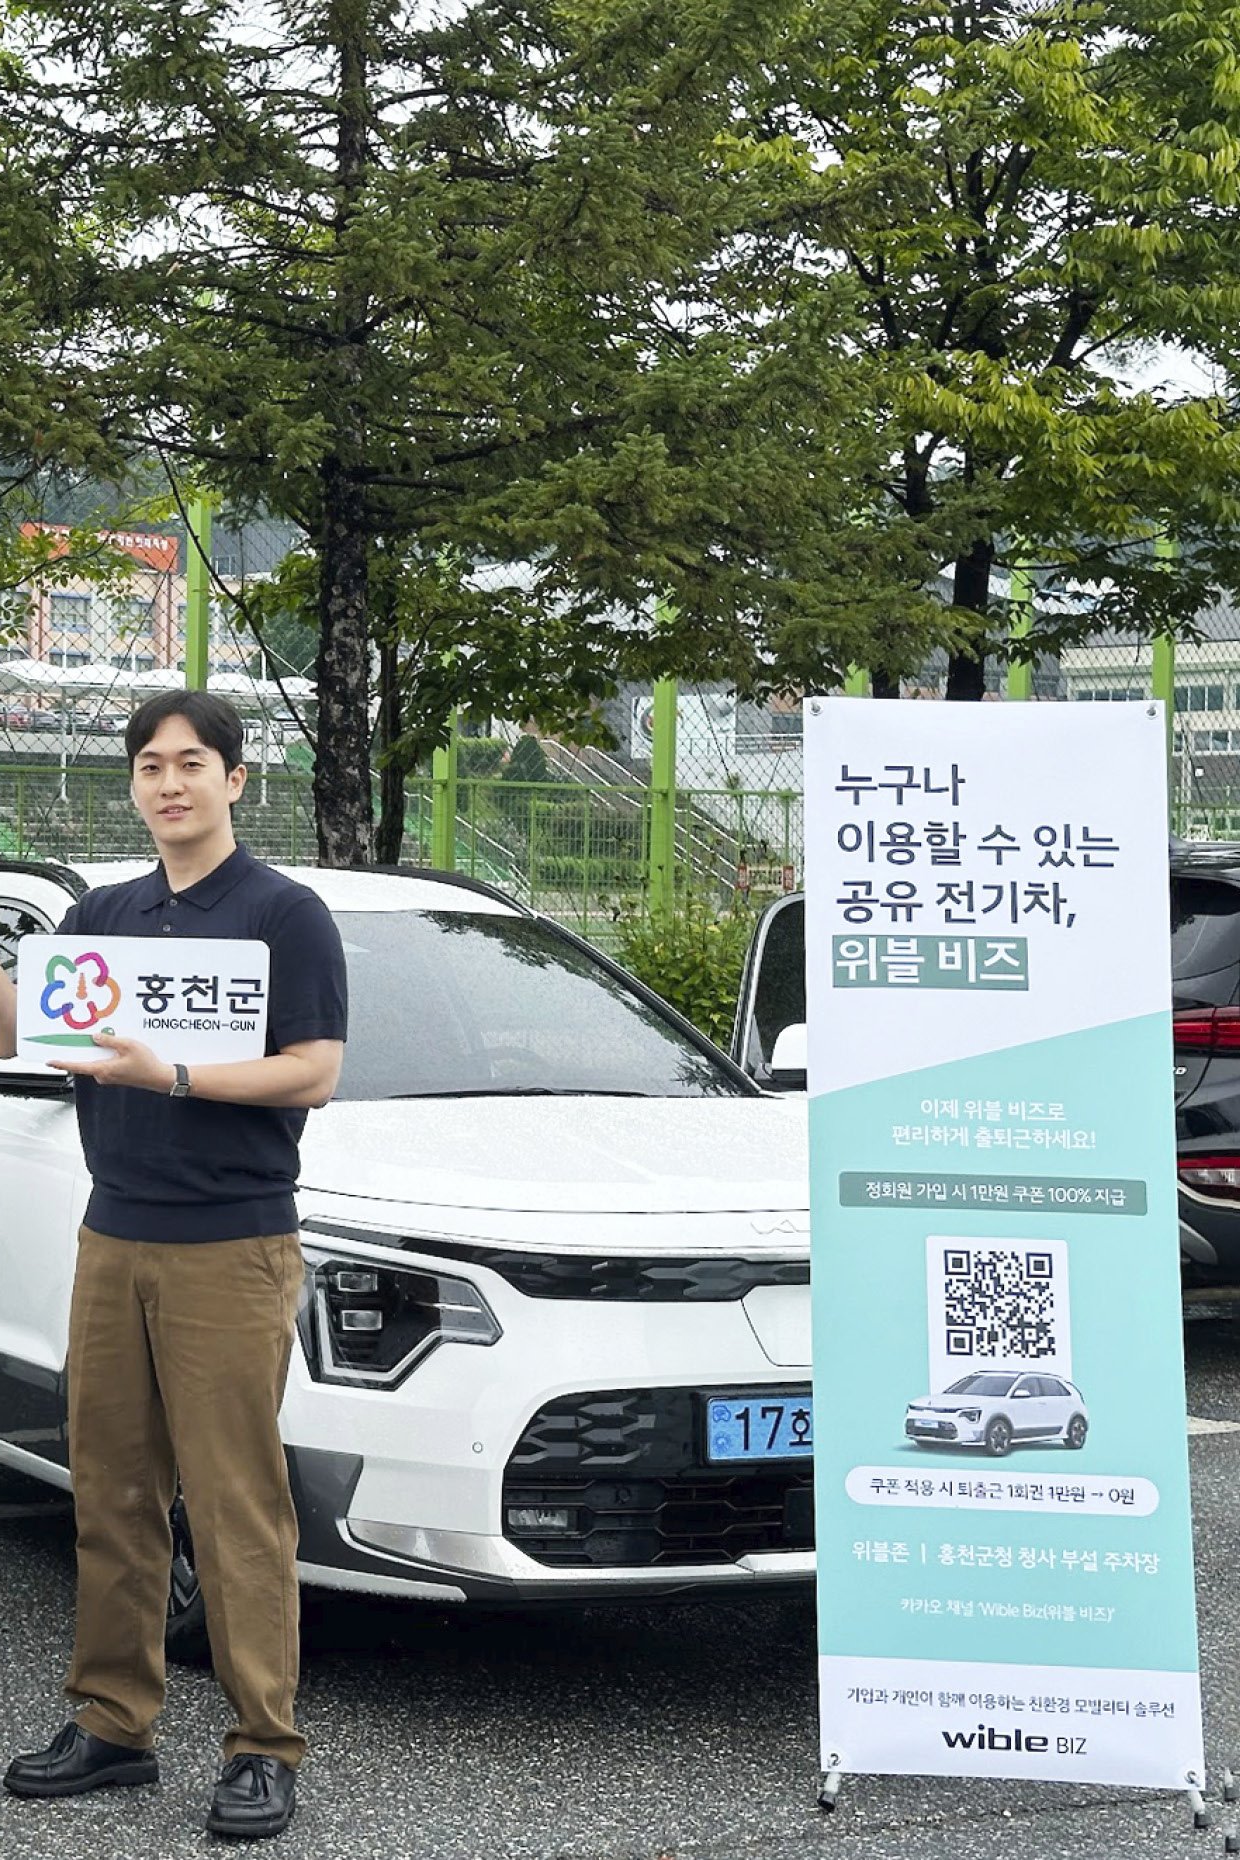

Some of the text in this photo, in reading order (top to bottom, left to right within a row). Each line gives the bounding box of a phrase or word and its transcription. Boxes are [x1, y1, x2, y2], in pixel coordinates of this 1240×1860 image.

[835, 763, 966, 806] 누구나
[837, 820, 1120, 868] 이용할 수 있는
[836, 880, 1076, 928] 공유 전기차,
[836, 937, 1025, 984] 위블 비즈
[135, 973, 265, 1015] 홍천군
[142, 1017, 256, 1032] HONGCHEON-GUN
[920, 1099, 1067, 1121] 이제 위블 비즈로
[892, 1125, 1097, 1150] 편리하게 출퇴근하세요!
[866, 1181, 1126, 1206] 정회원 가입 시 1만원 쿠폰 100% 지급
[734, 1406, 813, 1451] 17호
[869, 1478, 901, 1495] 쿠폰
[904, 1479, 934, 1496] 적용
[938, 1480, 953, 1497] 시
[958, 1481, 1004, 1500] 퇴출근
[1048, 1485, 1085, 1502] 1만원
[1108, 1487, 1135, 1505] 0원
[852, 1540, 1161, 1574] 위블존 홍천군청 청사 부설 주차장
[900, 1598, 943, 1615] 카카오
[946, 1600, 974, 1617] 채널
[846, 1687, 1175, 1718] 기업과 개인이 함께 이용하는 친환경 모빌리티 솔루션
[942, 1724, 1087, 1755] wible BIZ
